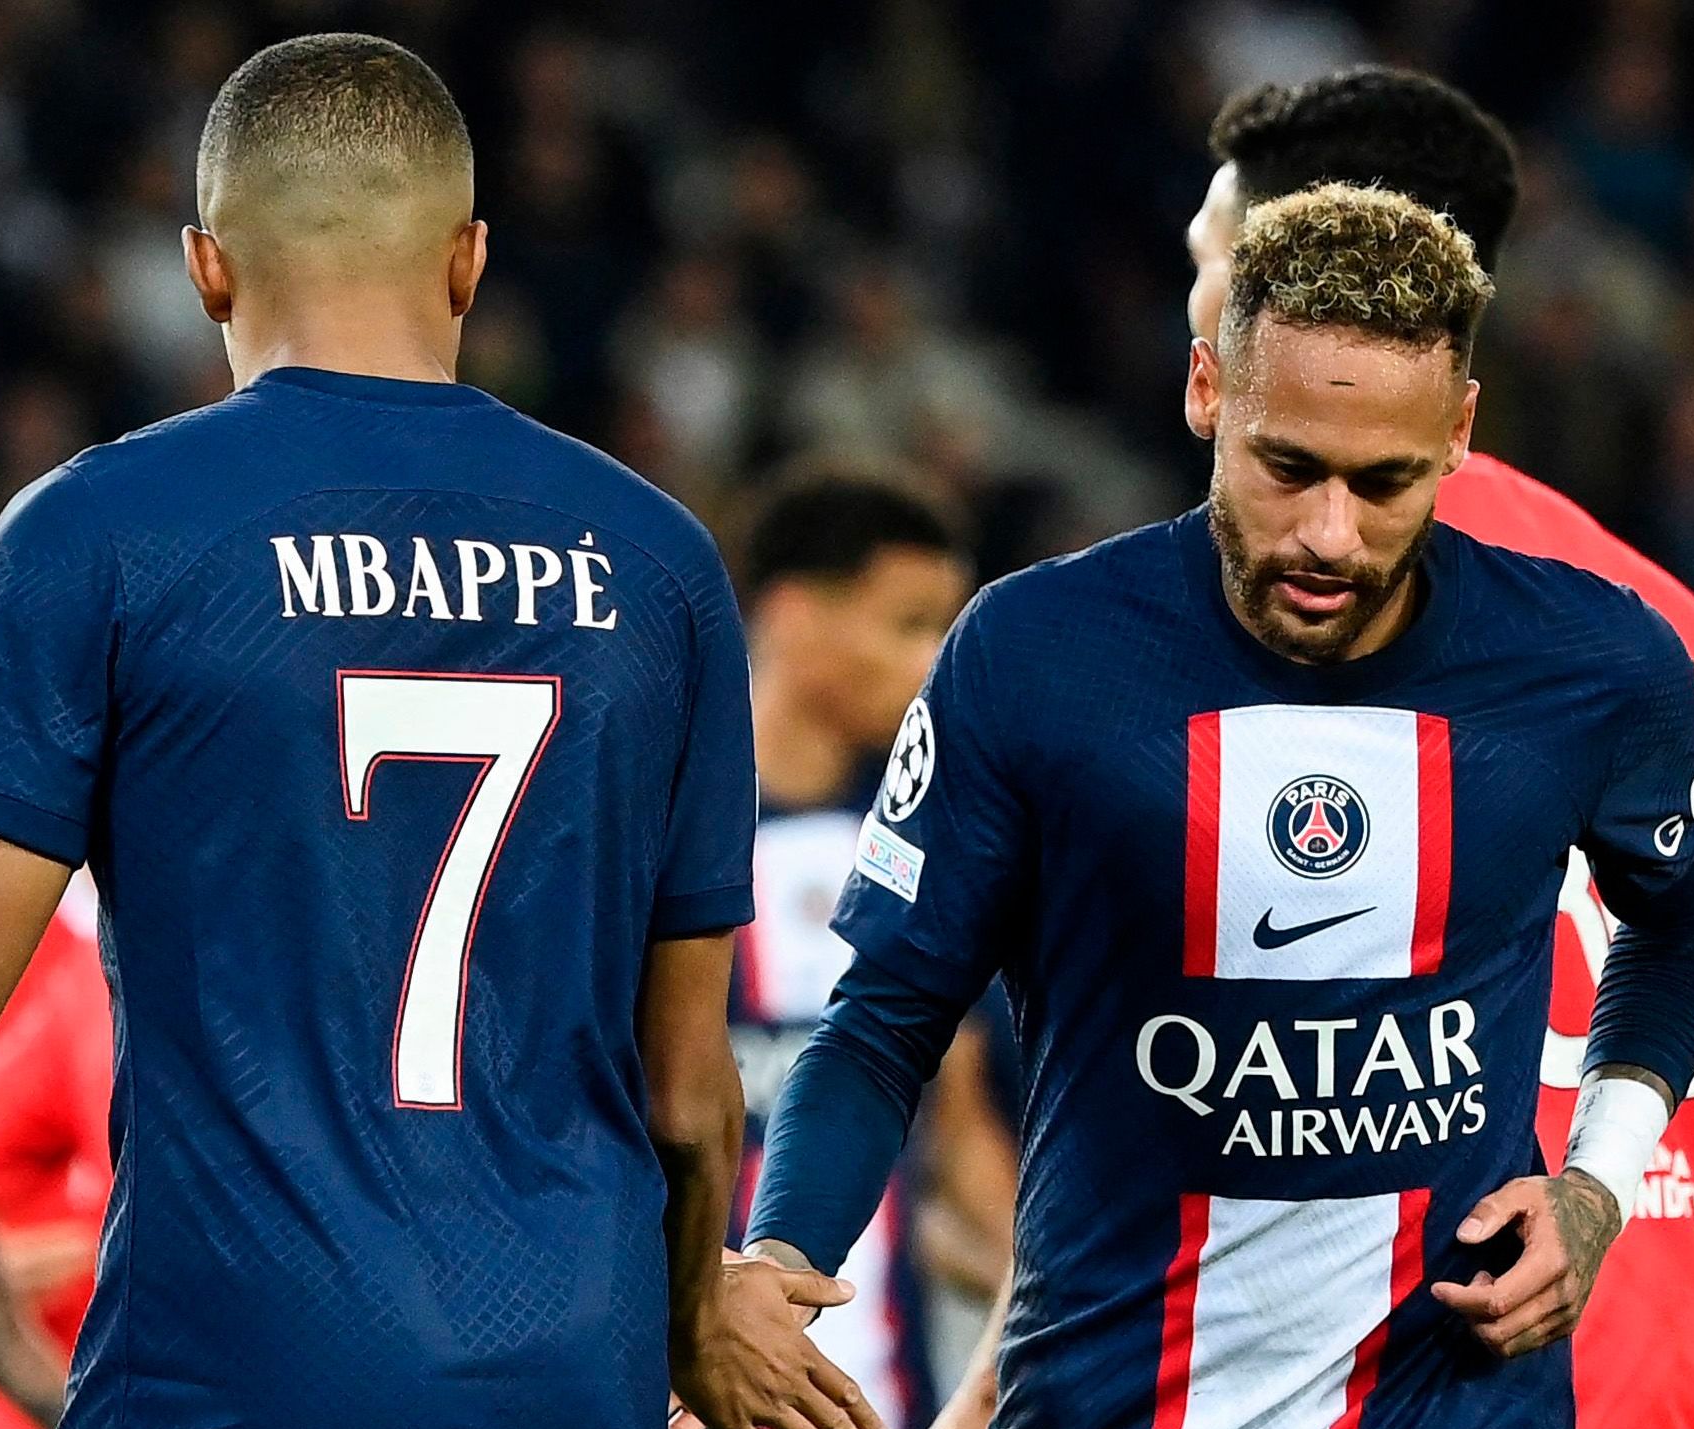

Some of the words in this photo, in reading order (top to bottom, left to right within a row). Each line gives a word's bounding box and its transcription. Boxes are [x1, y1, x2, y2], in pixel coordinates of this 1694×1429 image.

[269, 531, 618, 630] MBAPPÉ
[1285, 782, 1350, 807] PARIS
[336, 668, 561, 1110] 7
[1136, 1000, 1482, 1117] QATAR
[1221, 1084, 1486, 1156] AIRWAYS
